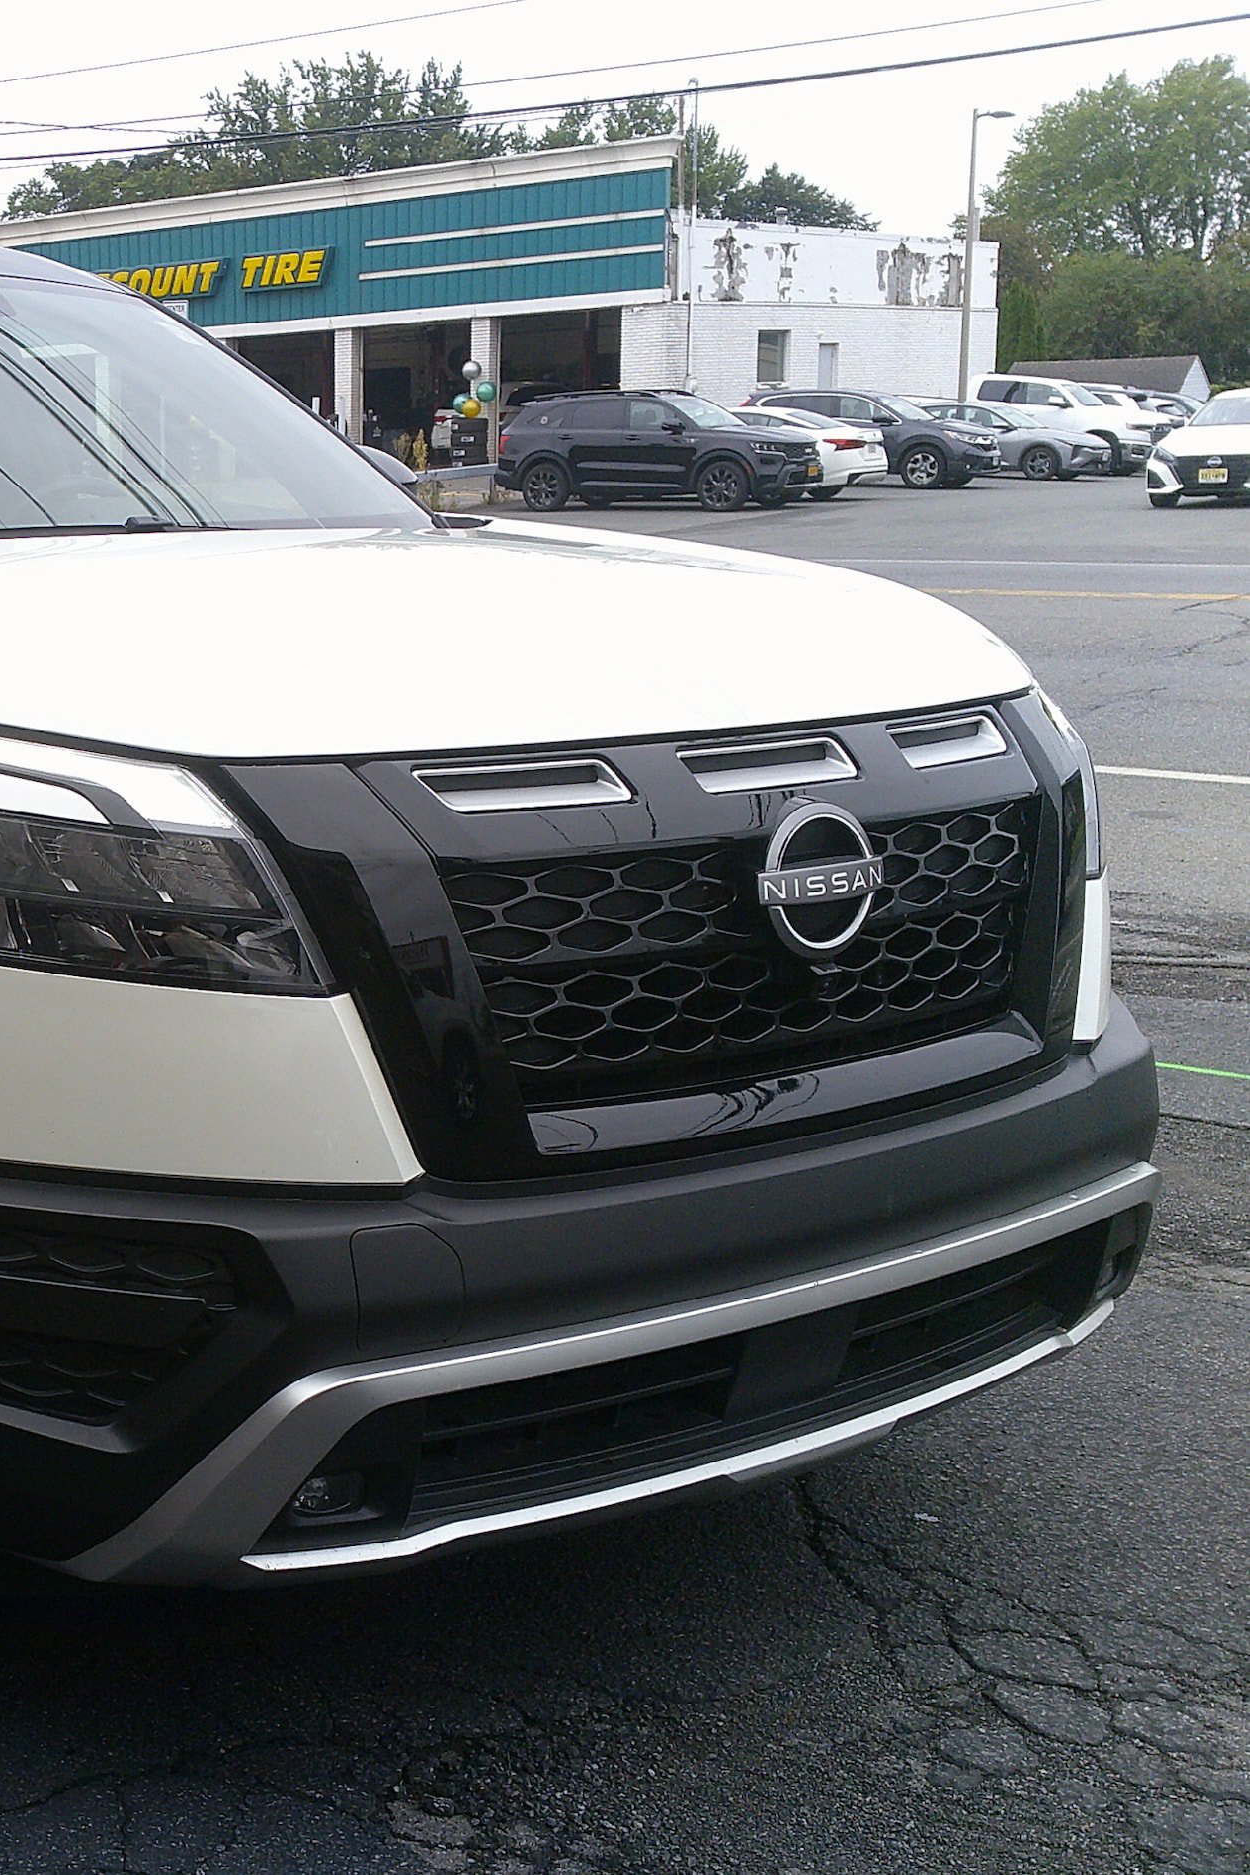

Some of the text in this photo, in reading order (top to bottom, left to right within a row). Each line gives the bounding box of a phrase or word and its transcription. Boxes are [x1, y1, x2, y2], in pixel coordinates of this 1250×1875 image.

[97, 250, 326, 298] OUNT TIRE
[763, 864, 883, 901] NISSAN
